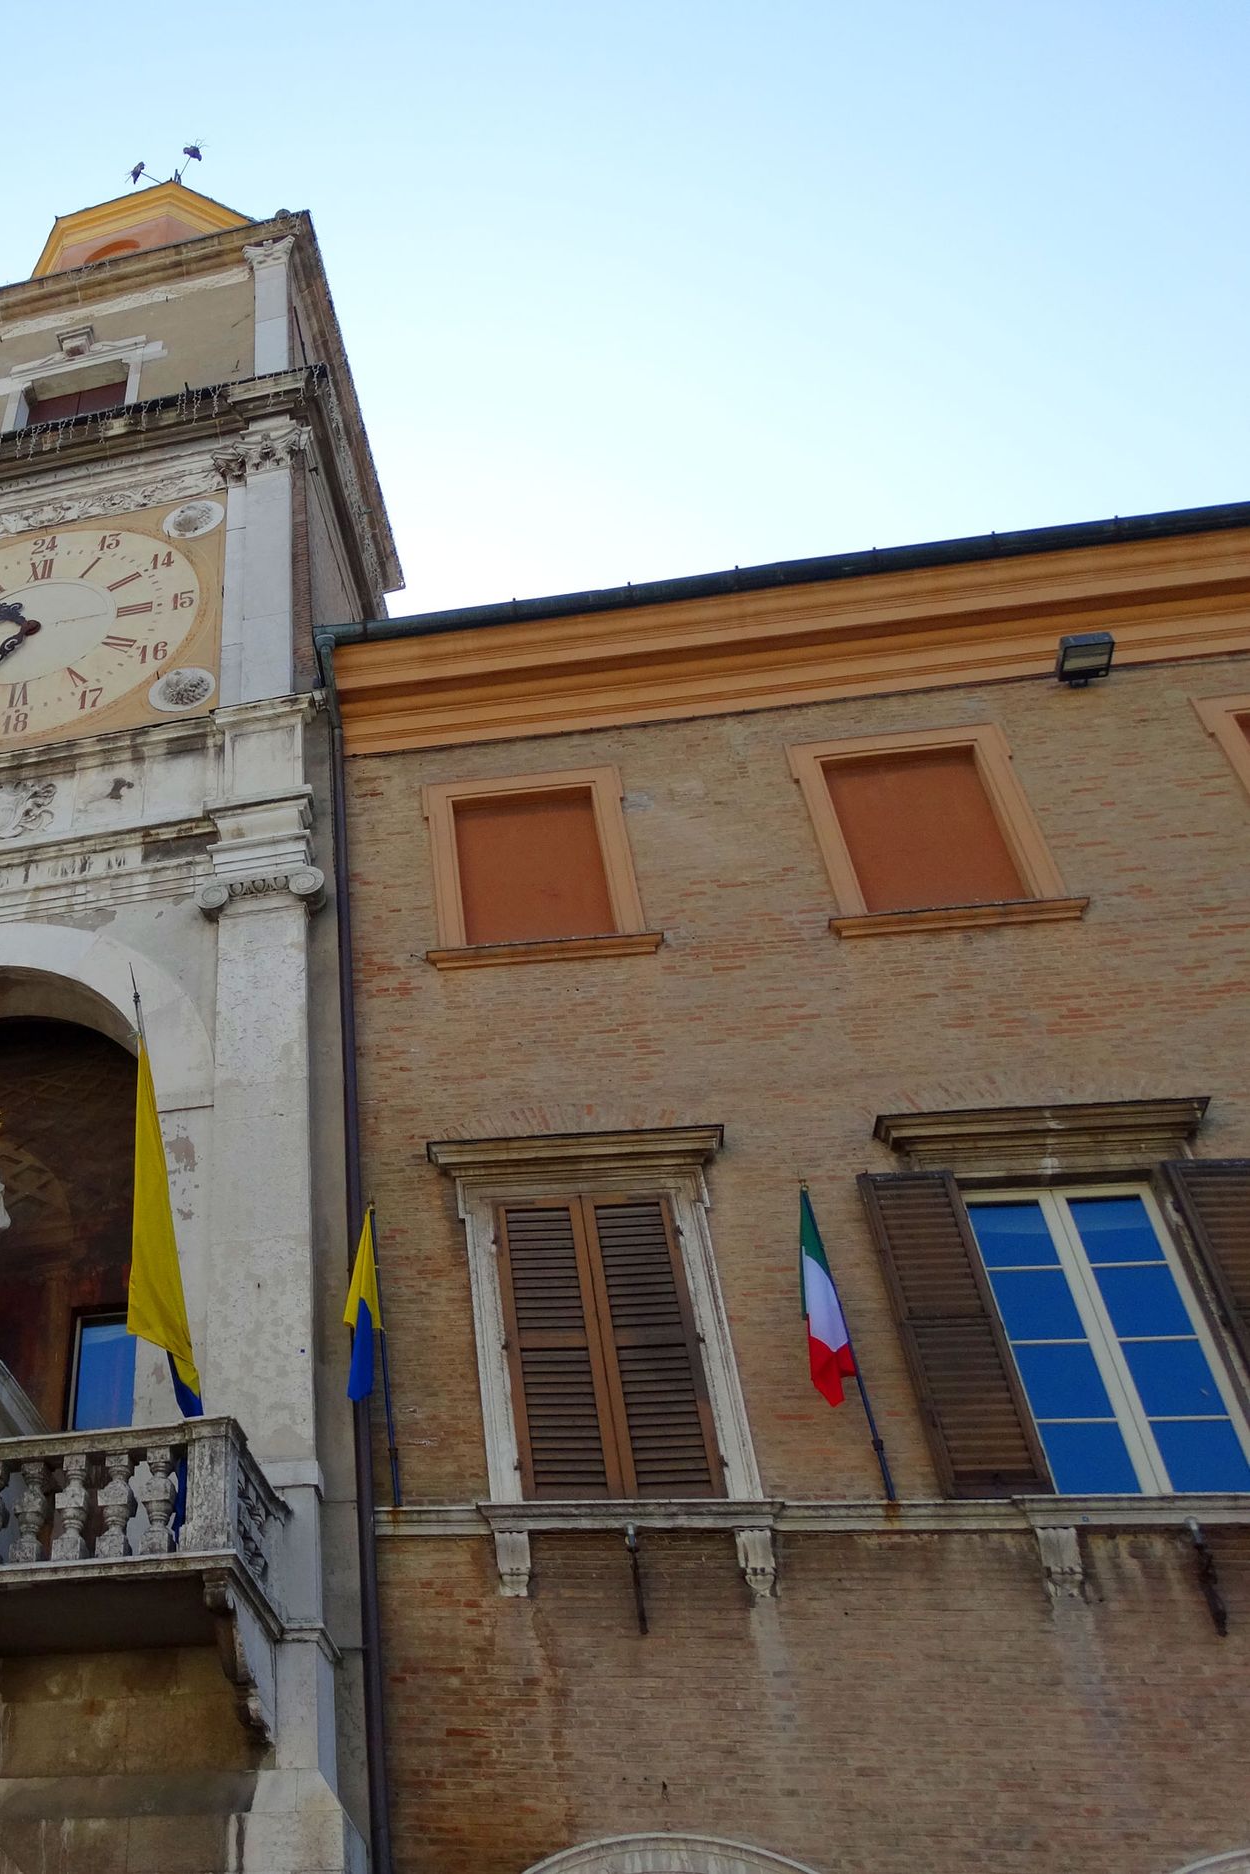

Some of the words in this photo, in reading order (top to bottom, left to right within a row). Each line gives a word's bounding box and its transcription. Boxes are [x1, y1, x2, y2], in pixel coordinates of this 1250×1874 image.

[31, 536, 58, 555] 24
[98, 533, 122, 551] 13
[26, 558, 54, 583] XII
[150, 551, 175, 569] 14
[171, 590, 194, 610] 15
[137, 641, 168, 664] 16
[78, 687, 103, 710] 17
[3, 712, 28, 735] 18
